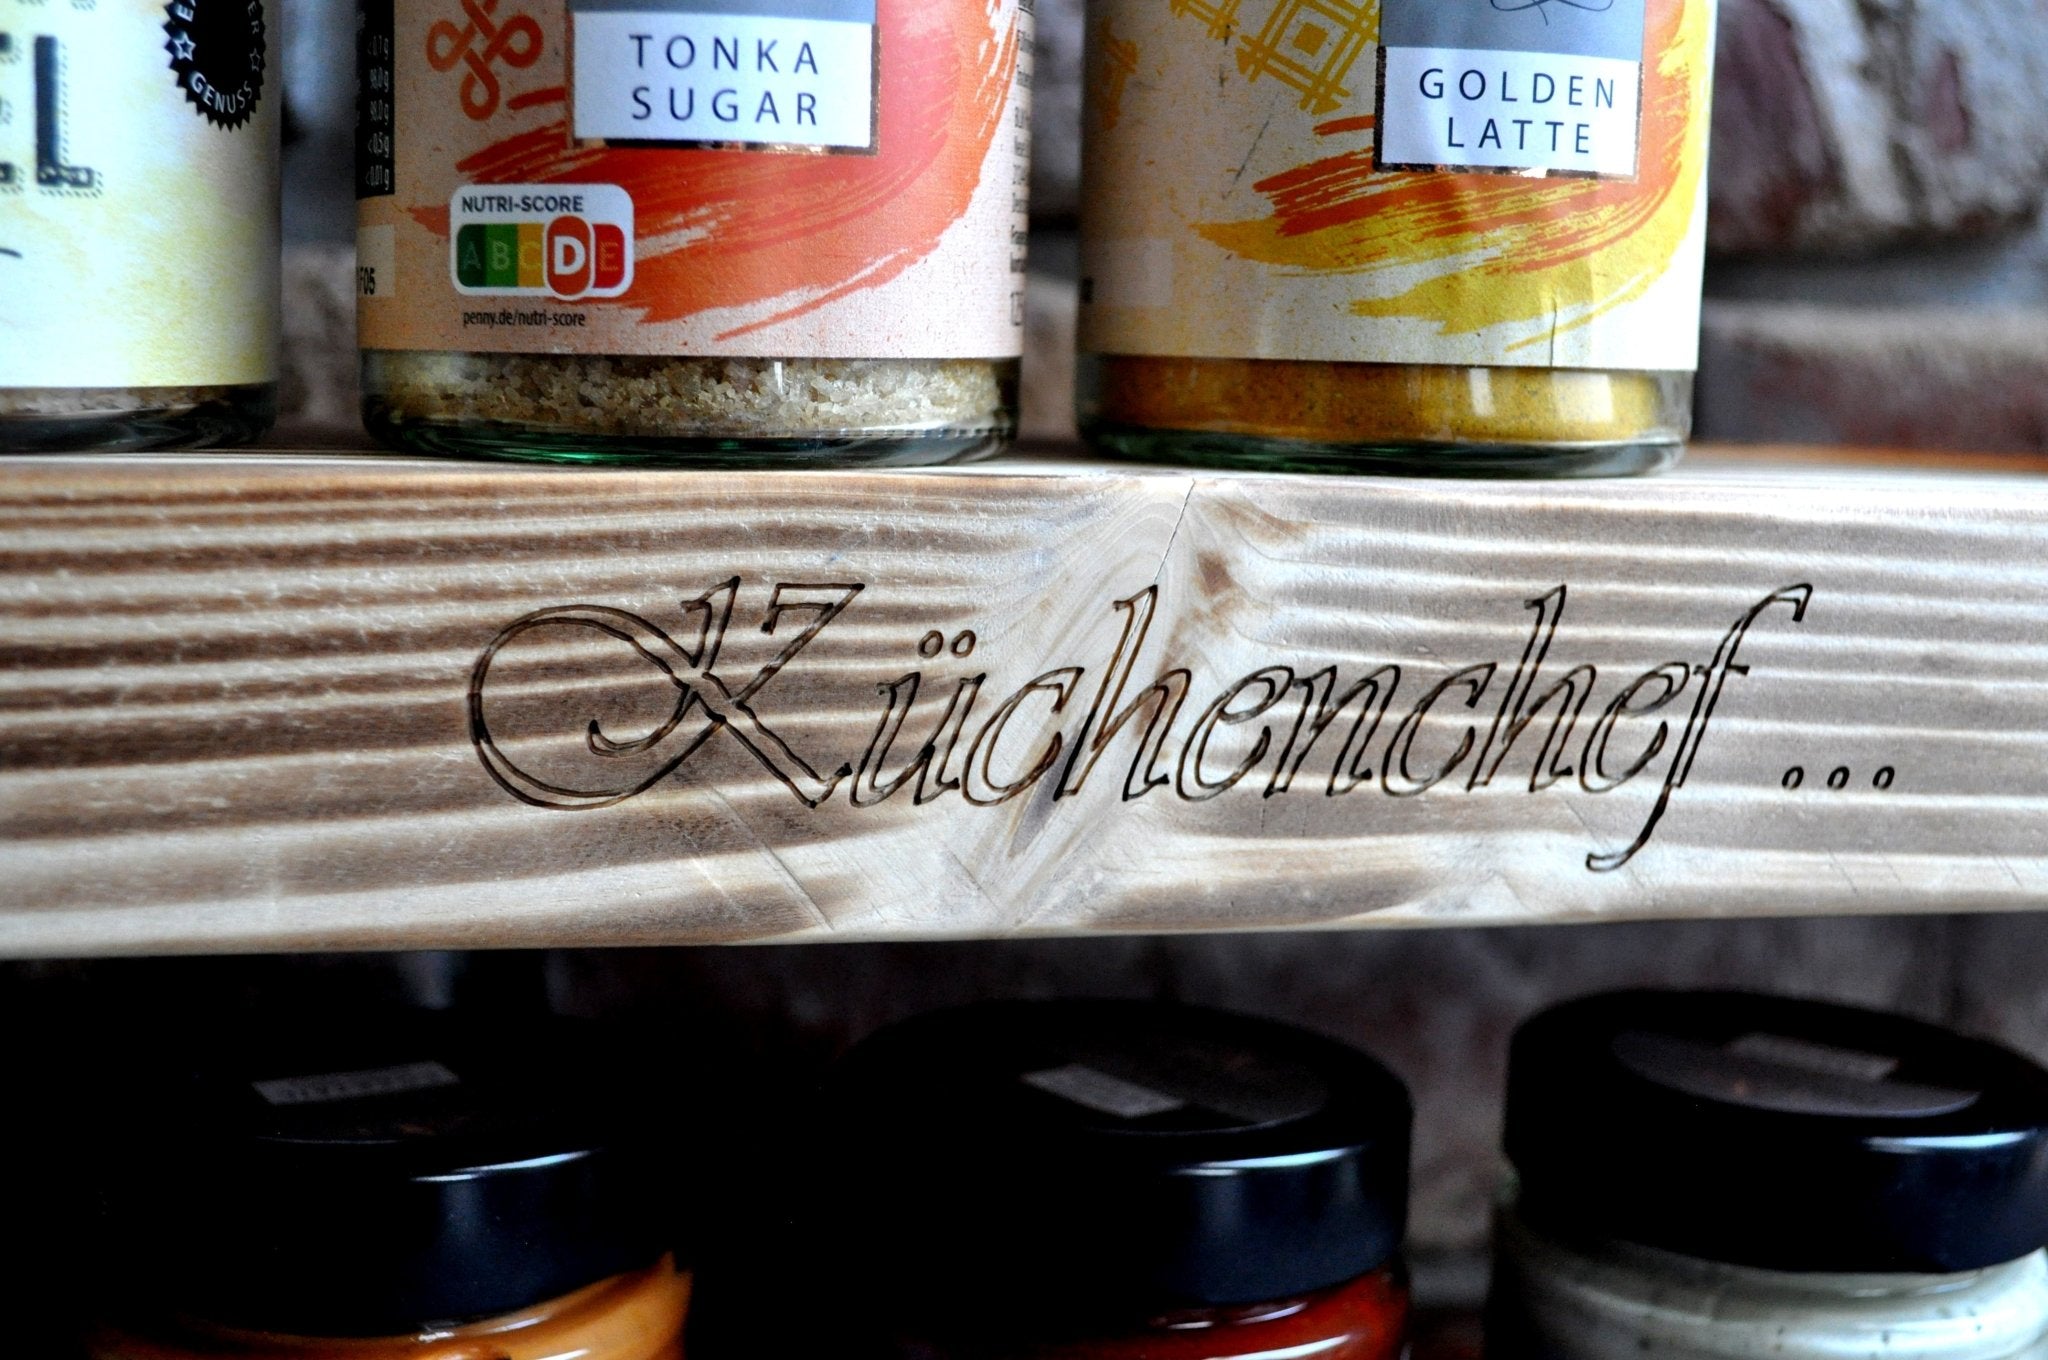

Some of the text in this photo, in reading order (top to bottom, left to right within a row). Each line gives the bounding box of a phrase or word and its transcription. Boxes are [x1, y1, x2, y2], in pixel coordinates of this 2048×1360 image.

[629, 34, 818, 74] TONKA
[189, 71, 253, 114] GENUSS
[632, 87, 816, 125] SUGAR
[1419, 68, 1614, 108] GOLDEN
[1448, 117, 1590, 153] LATTE
[462, 196, 584, 212] NUTRI-SCORE
[463, 235, 618, 275] A B C D E
[463, 309, 586, 329] penny.de/nutri-score
[469, 575, 1813, 871] Küchenchef
